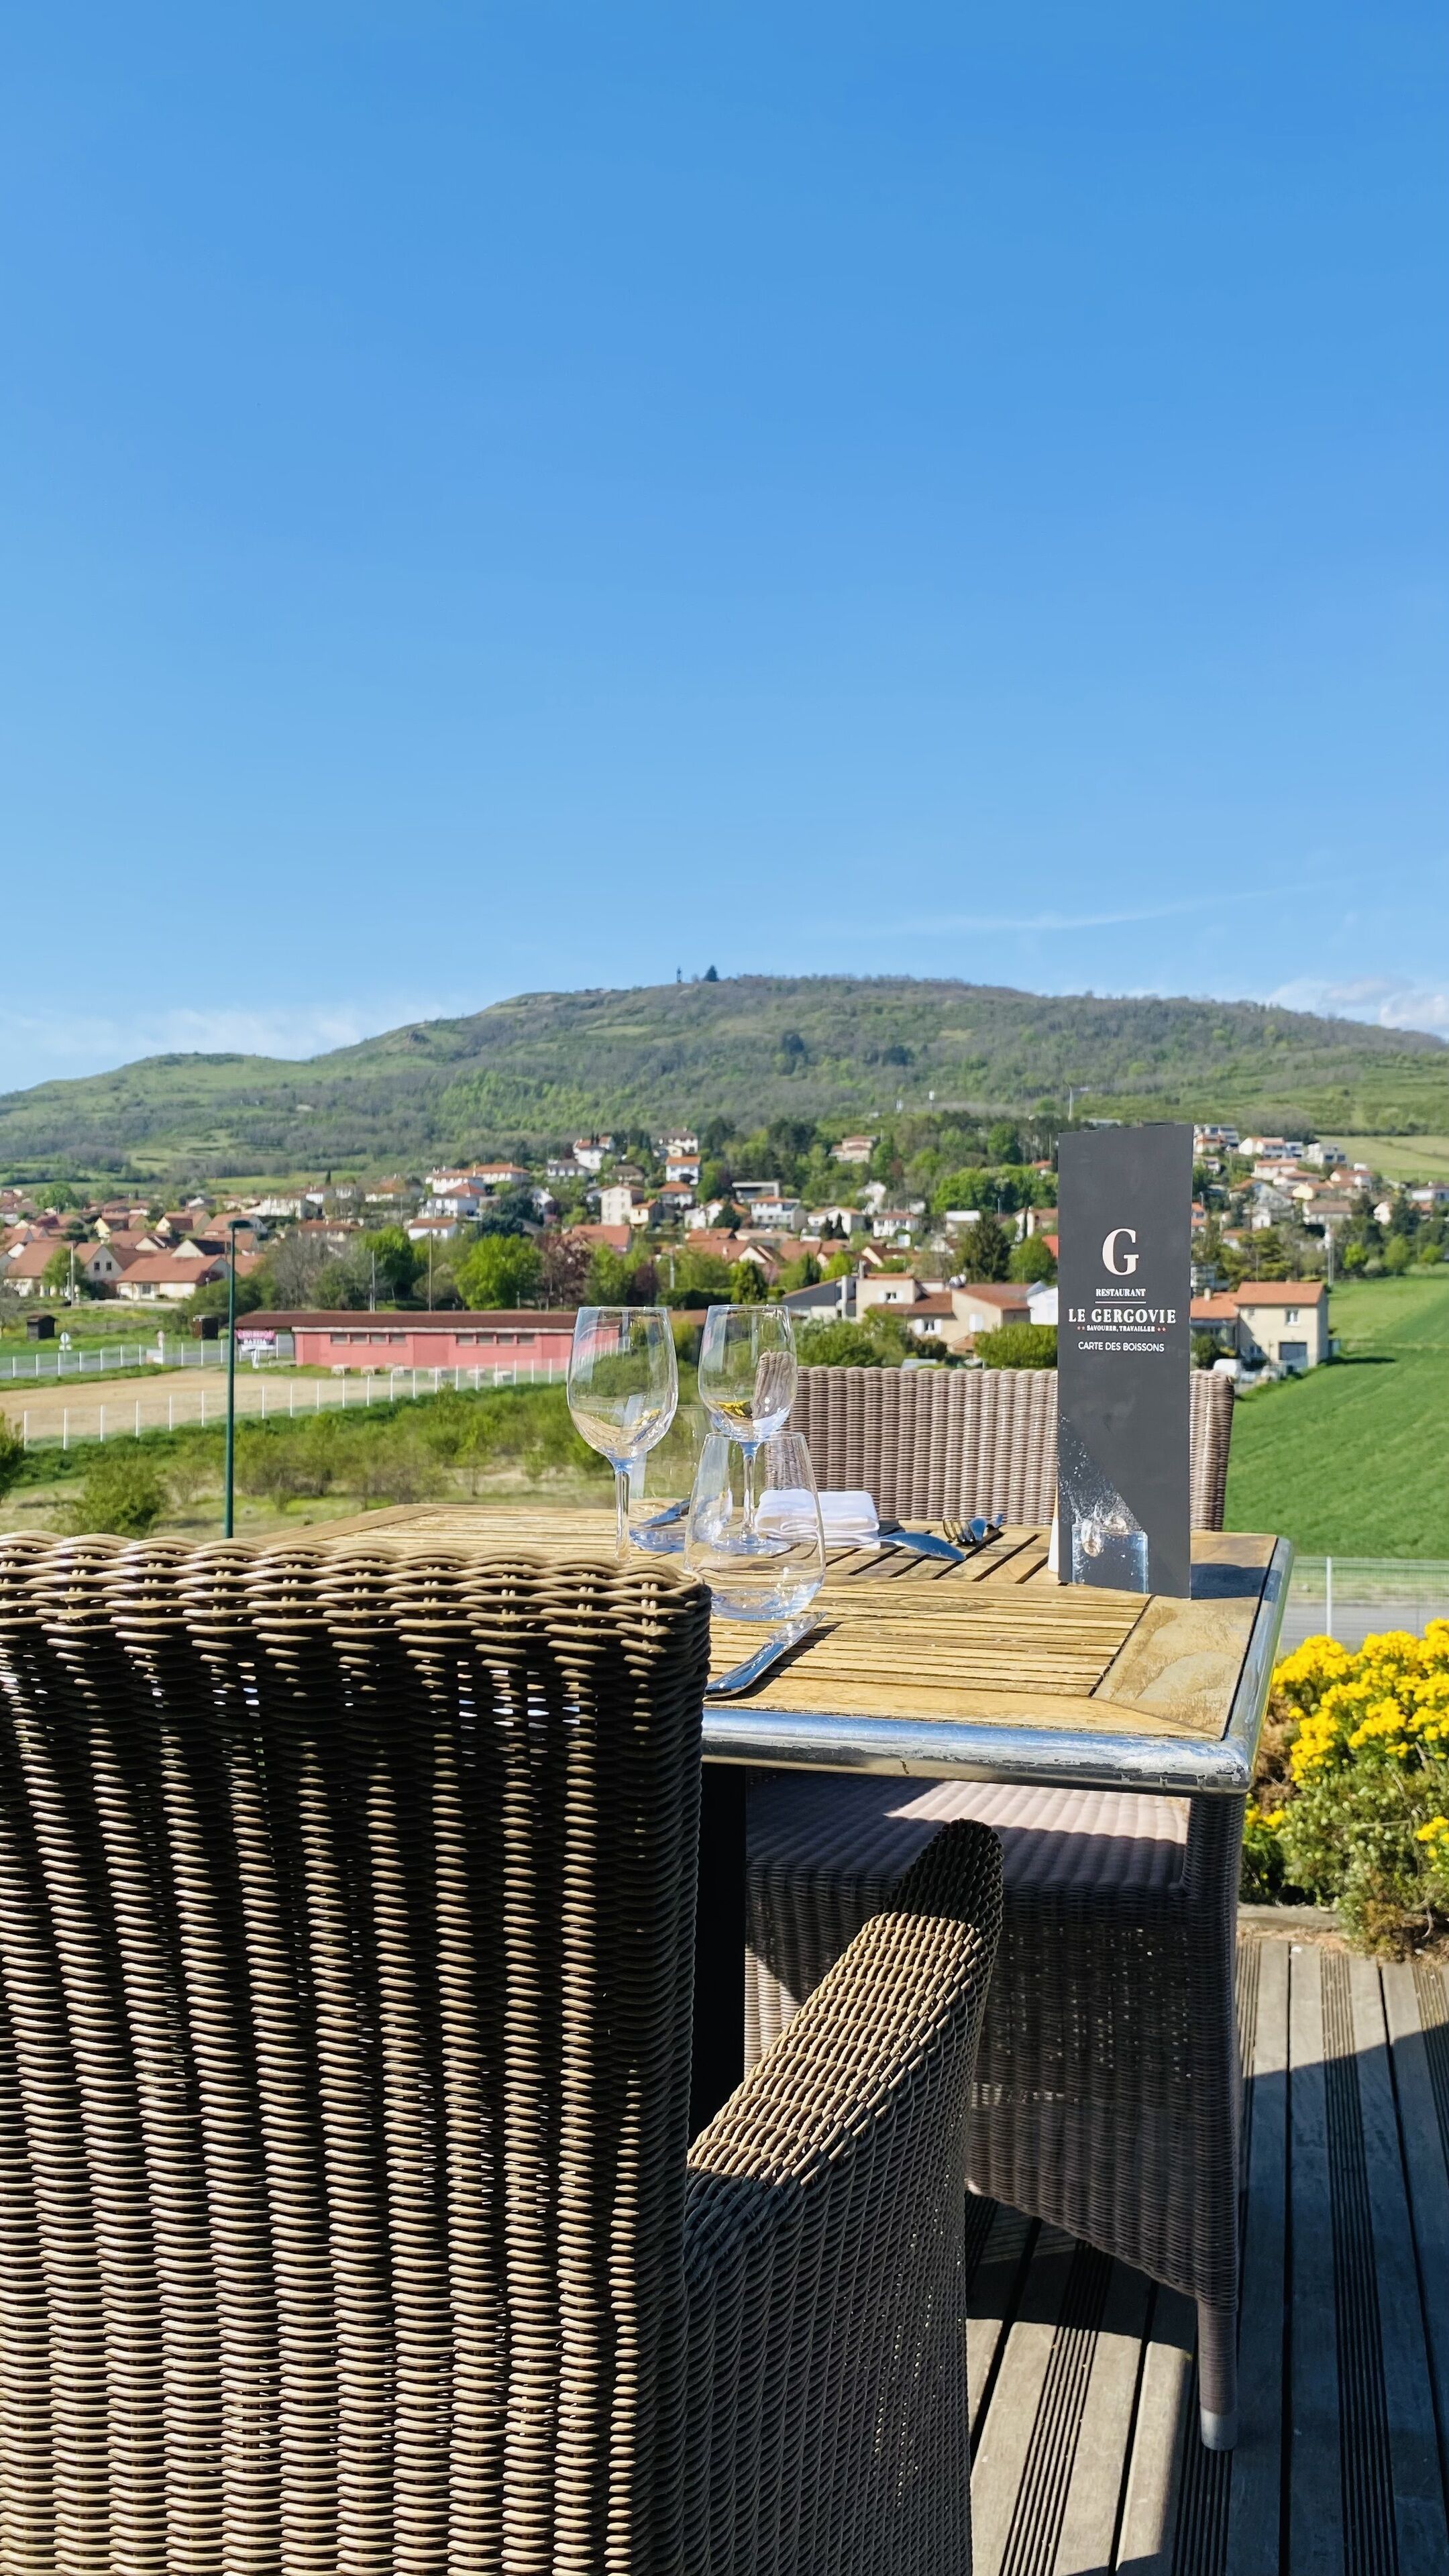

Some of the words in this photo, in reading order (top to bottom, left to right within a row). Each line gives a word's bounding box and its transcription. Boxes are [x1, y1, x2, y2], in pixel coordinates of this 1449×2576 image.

[1102, 1228, 1139, 1275] G
[1095, 1289, 1146, 1297] RESTAURANT
[1069, 1309, 1085, 1322] LE
[1091, 1309, 1176, 1324] GERGOVIE
[1078, 1342, 1103, 1350] CARTE
[1106, 1342, 1121, 1351] DES
[1123, 1342, 1165, 1352] BOISSONS
